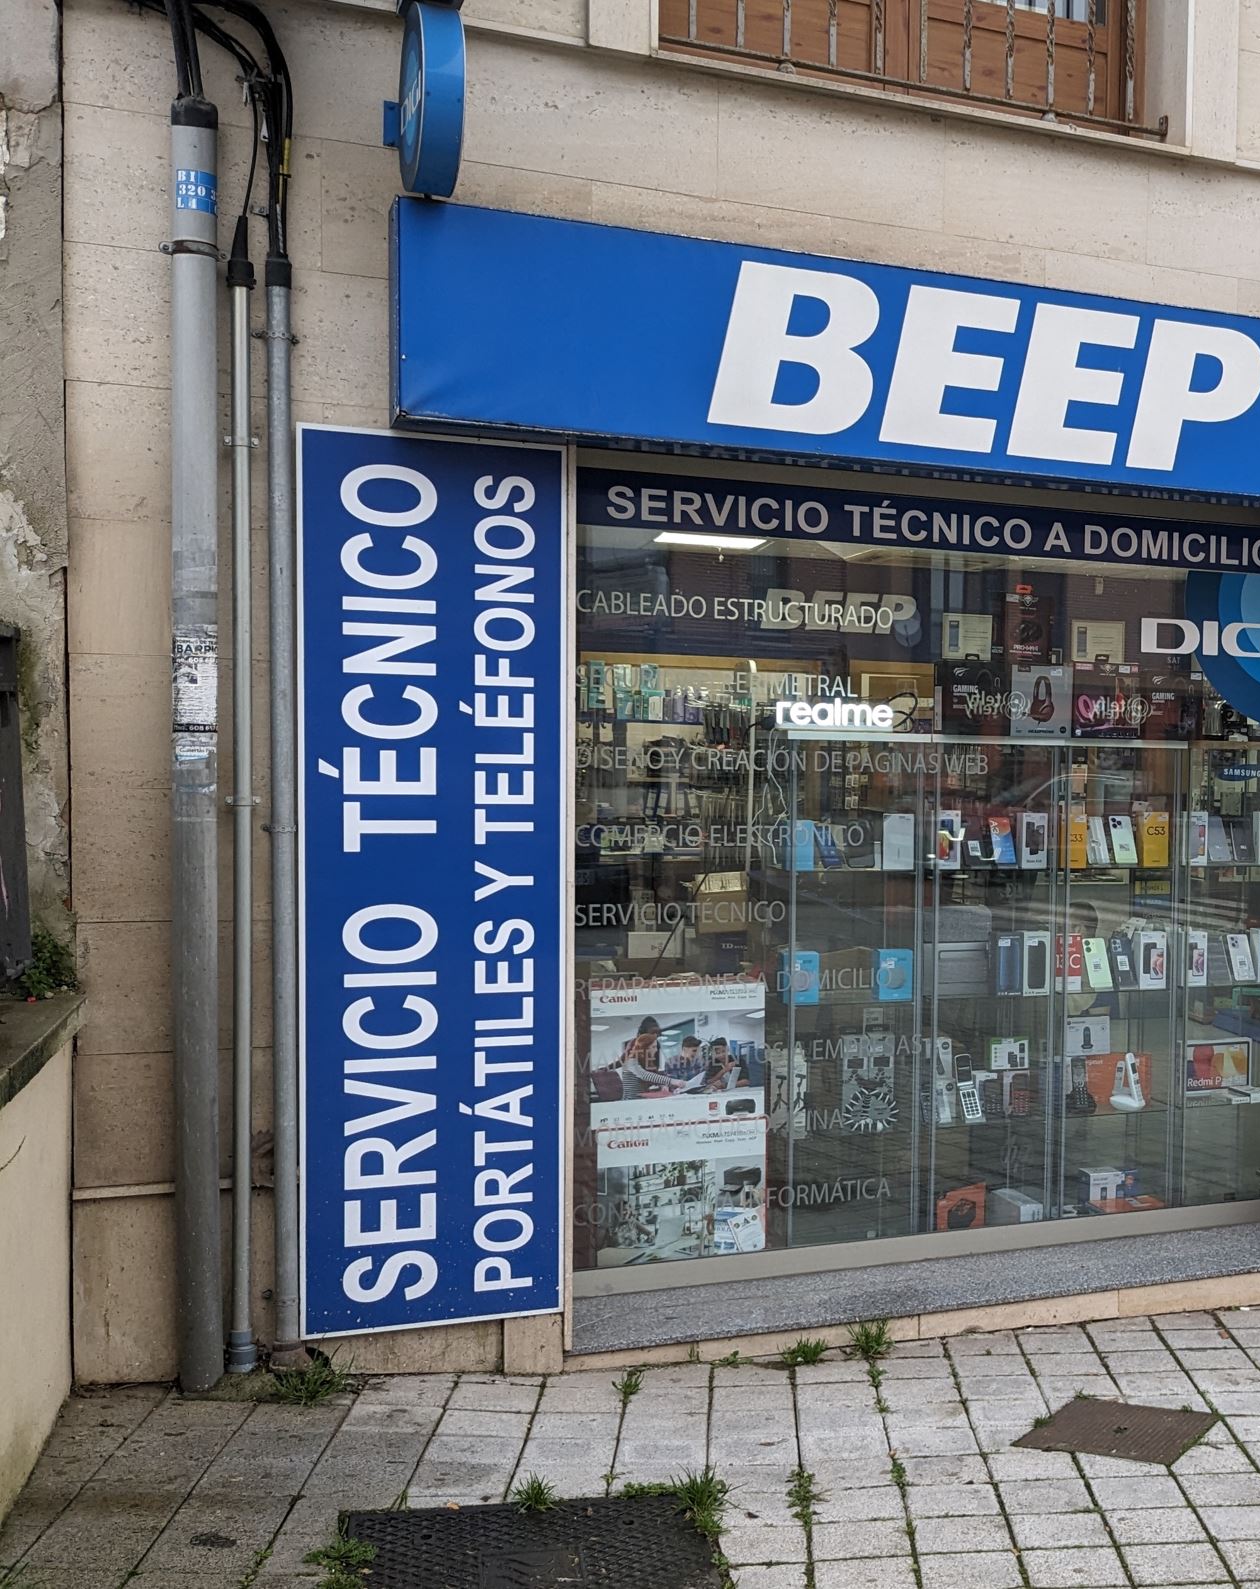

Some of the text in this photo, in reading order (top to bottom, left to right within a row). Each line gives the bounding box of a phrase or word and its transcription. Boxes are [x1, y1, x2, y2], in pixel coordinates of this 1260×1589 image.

[401, 69, 422, 136] DIGI
[605, 485, 830, 535] SERVICIO
[843, 500, 1033, 550] TÉCNICO
[1043, 522, 1072, 552] A
[575, 589, 894, 629] CABLEADO ESTRUCTURADO
[759, 587, 918, 635] BEEP
[952, 684, 979, 693] GAMING
[1151, 691, 1175, 701] GAMING
[775, 697, 894, 728] realme
[671, 747, 686, 770] Y
[814, 751, 842, 773] DE
[944, 753, 989, 776] WEB
[575, 824, 702, 848] COMERCIO
[1146, 825, 1166, 836] C53
[318, 463, 439, 1304] SERVICIO TÉCNICO
[459, 474, 536, 1293] PORTÁTILES Y TELÉFONOS
[575, 898, 786, 927] SERVICIO TÉCNICO
[776, 967, 892, 993] DOMICILIO
[599, 994, 638, 1005] Canon
[1187, 1075, 1214, 1088] Redmi
[607, 1139, 649, 1150] Canon
